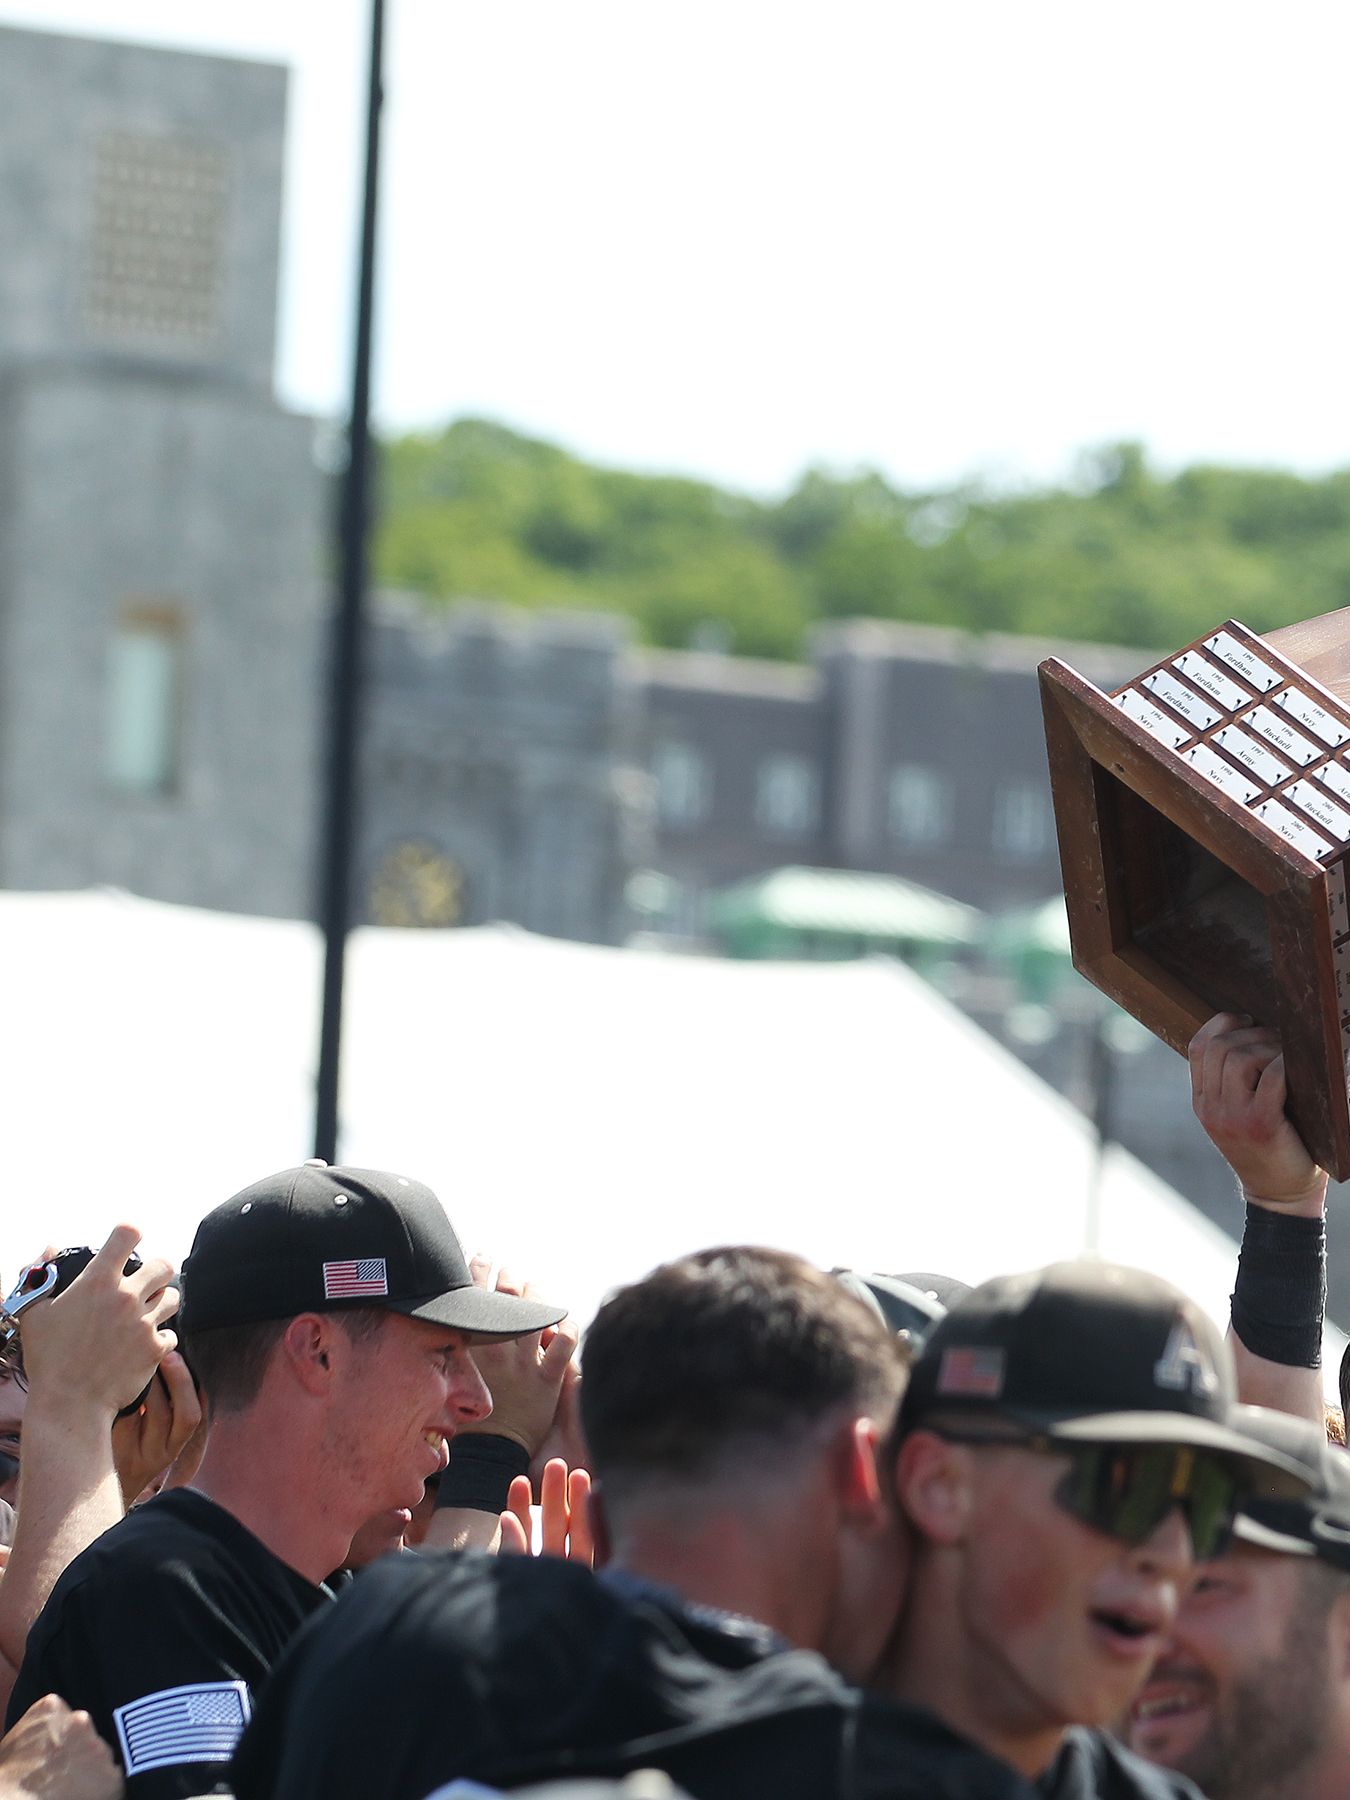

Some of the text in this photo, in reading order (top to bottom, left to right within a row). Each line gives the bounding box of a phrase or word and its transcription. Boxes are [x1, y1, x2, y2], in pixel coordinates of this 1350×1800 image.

[1224, 652, 1252, 676] Fordham
[1242, 652, 1255, 663] 1991
[1193, 672, 1221, 696] Fordham
[1211, 673, 1225, 683] 1992
[1181, 691, 1194, 701] 1993
[1162, 691, 1191, 715] Fordham
[1150, 710, 1163, 721] 1994
[1312, 708, 1325, 718] 1995
[1137, 715, 1154, 728] Navy
[1299, 713, 1316, 727] Navy
[1263, 727, 1292, 750] Bucknell
[1281, 727, 1294, 737] 1996
[1251, 746, 1265, 755] 1997
[1237, 750, 1256, 765] Army
[1210, 770, 1225, 784] Navy
[1322, 801, 1335, 812] 2001
[1304, 802, 1333, 825] Bucknell
[1278, 825, 1295, 840] Navy
[1291, 821, 1305, 831] 2002
[1154, 1306, 1220, 1398] A
